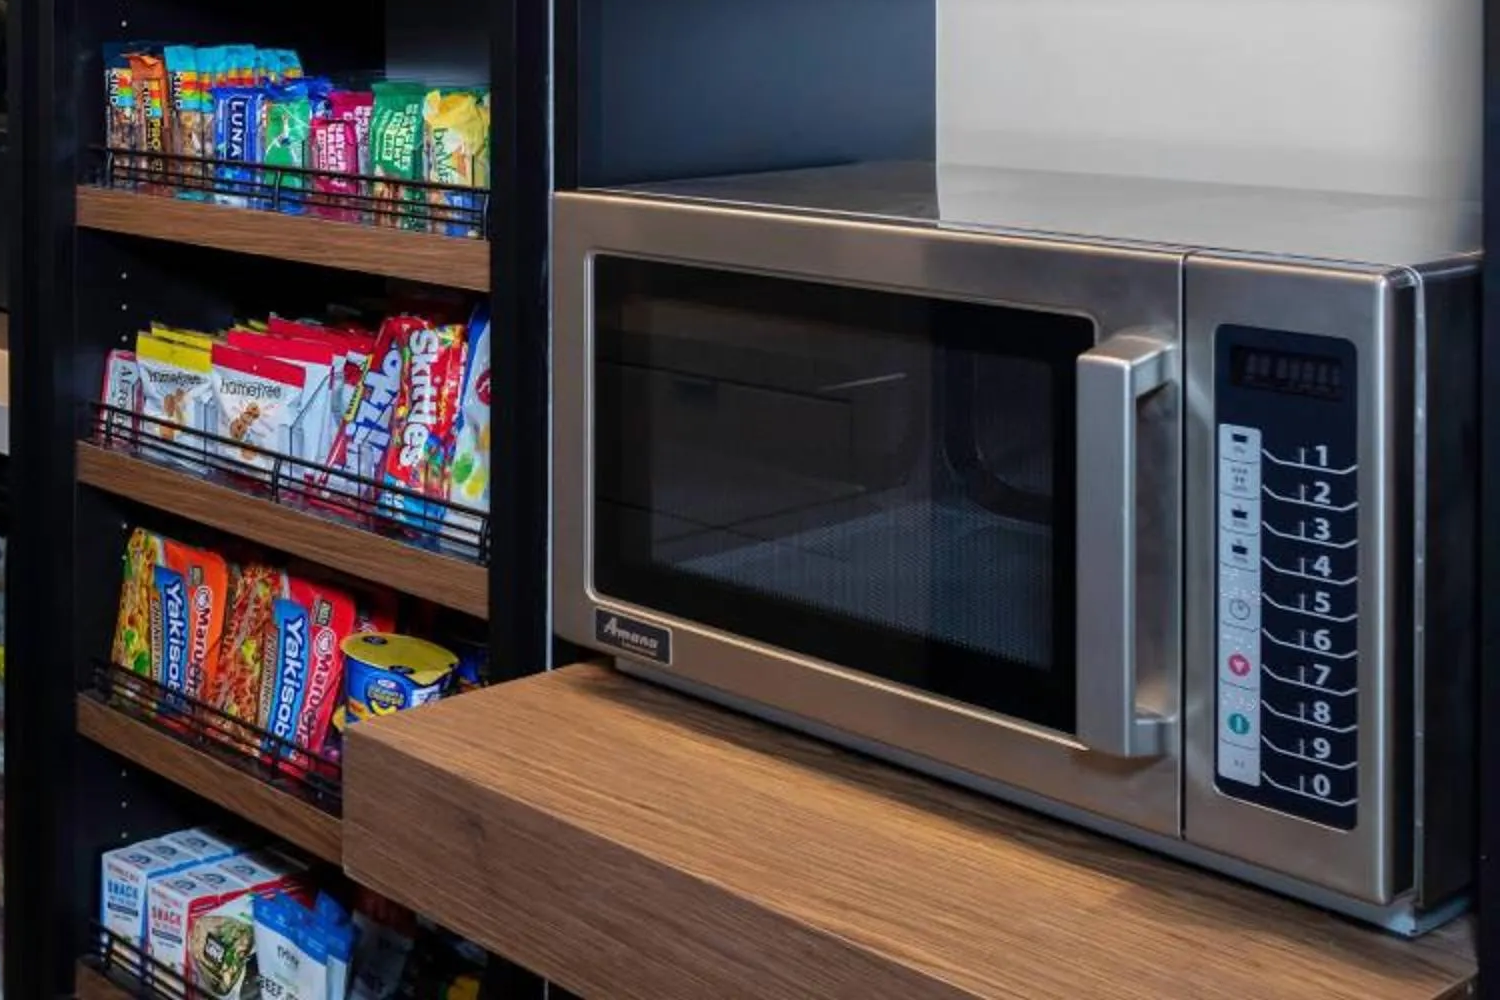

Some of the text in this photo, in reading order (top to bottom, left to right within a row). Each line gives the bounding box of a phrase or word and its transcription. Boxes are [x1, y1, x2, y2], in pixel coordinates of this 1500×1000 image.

[231, 100, 245, 158] LUNA
[219, 378, 282, 399] homefree
[399, 328, 439, 467] Skittles
[1315, 445, 1329, 467] 1
[1313, 481, 1331, 505] 2
[1313, 517, 1331, 541] 3
[1313, 554, 1332, 577] 4
[1314, 591, 1331, 613] 5
[603, 616, 659, 650] Amana
[1313, 628, 1332, 651] 6
[274, 616, 304, 737] Yakisob
[1313, 664, 1332, 686] 7
[1312, 701, 1332, 725] 8
[1312, 737, 1332, 760] 9
[1313, 774, 1332, 797] 0
